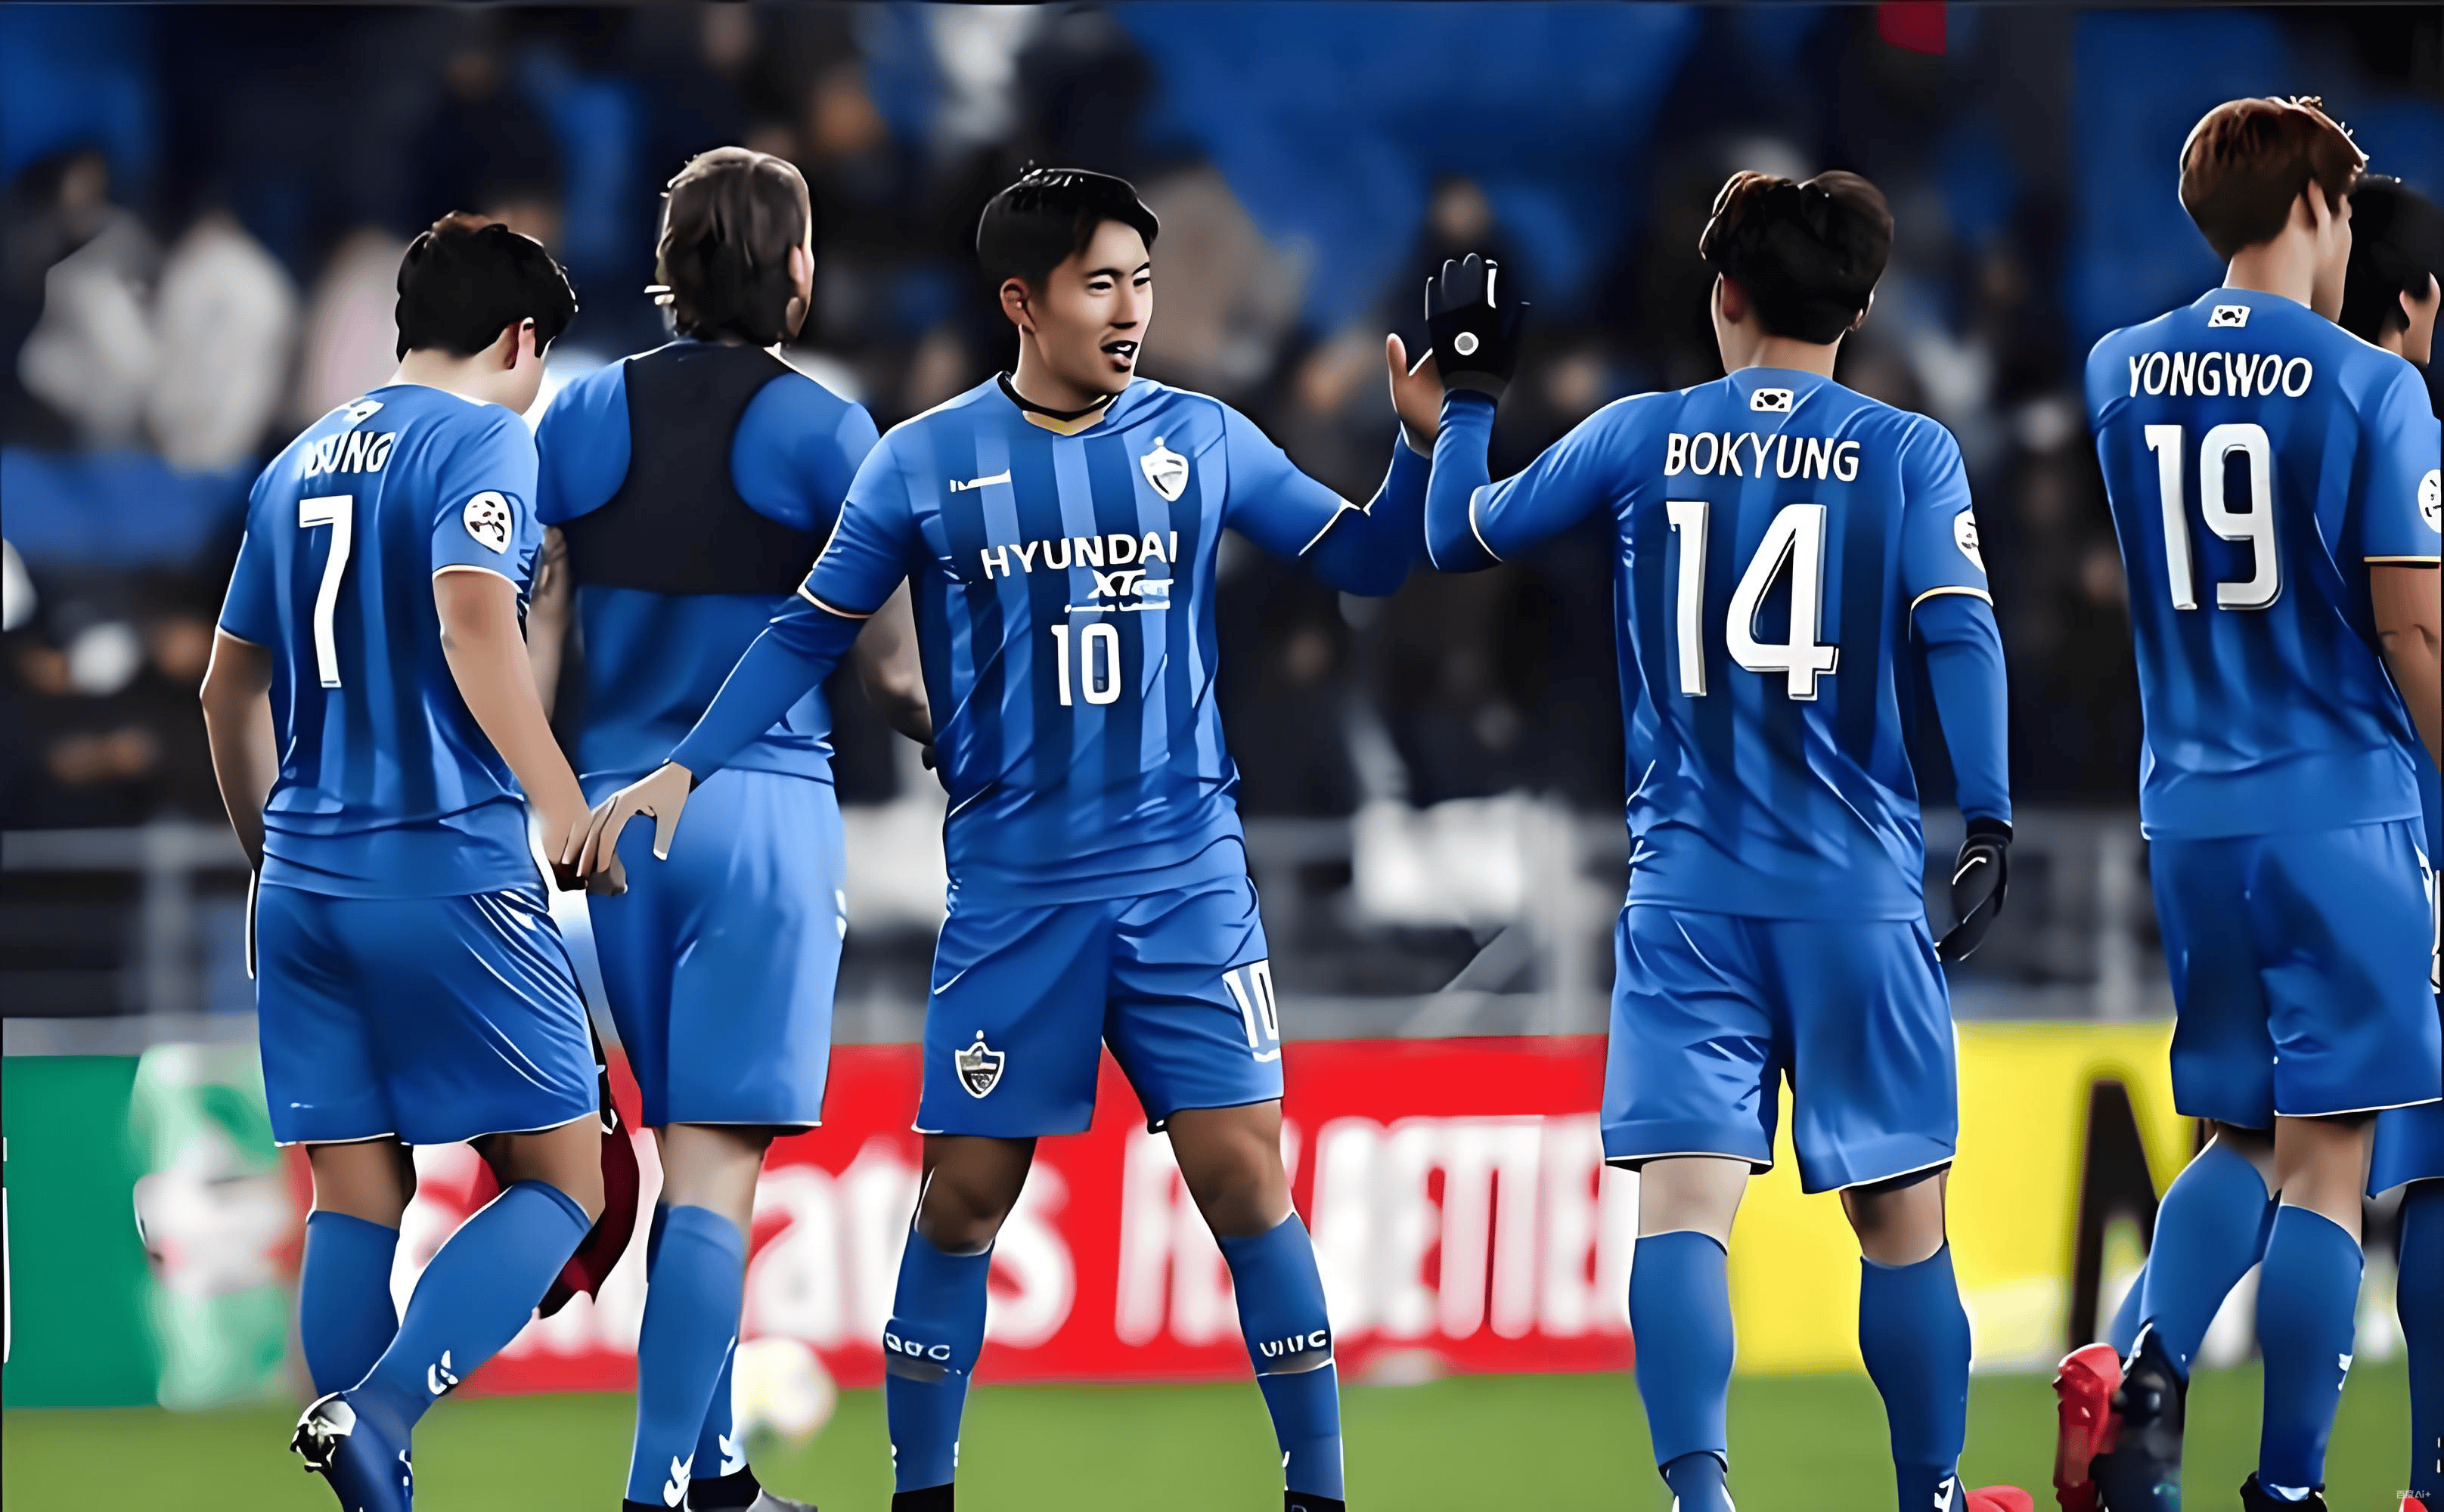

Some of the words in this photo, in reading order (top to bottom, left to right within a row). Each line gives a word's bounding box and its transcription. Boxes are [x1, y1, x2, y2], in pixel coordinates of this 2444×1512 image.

[2129, 351, 2313, 398] YONGWOO
[1664, 432, 1860, 482] BOKYUNG
[980, 531, 1178, 580] HYUNDAI
[2144, 423, 2280, 611] 19
[299, 494, 353, 688] 7
[1665, 501, 1839, 701] 14
[1050, 622, 1121, 706] 10
[1221, 959, 1281, 1063] 10
